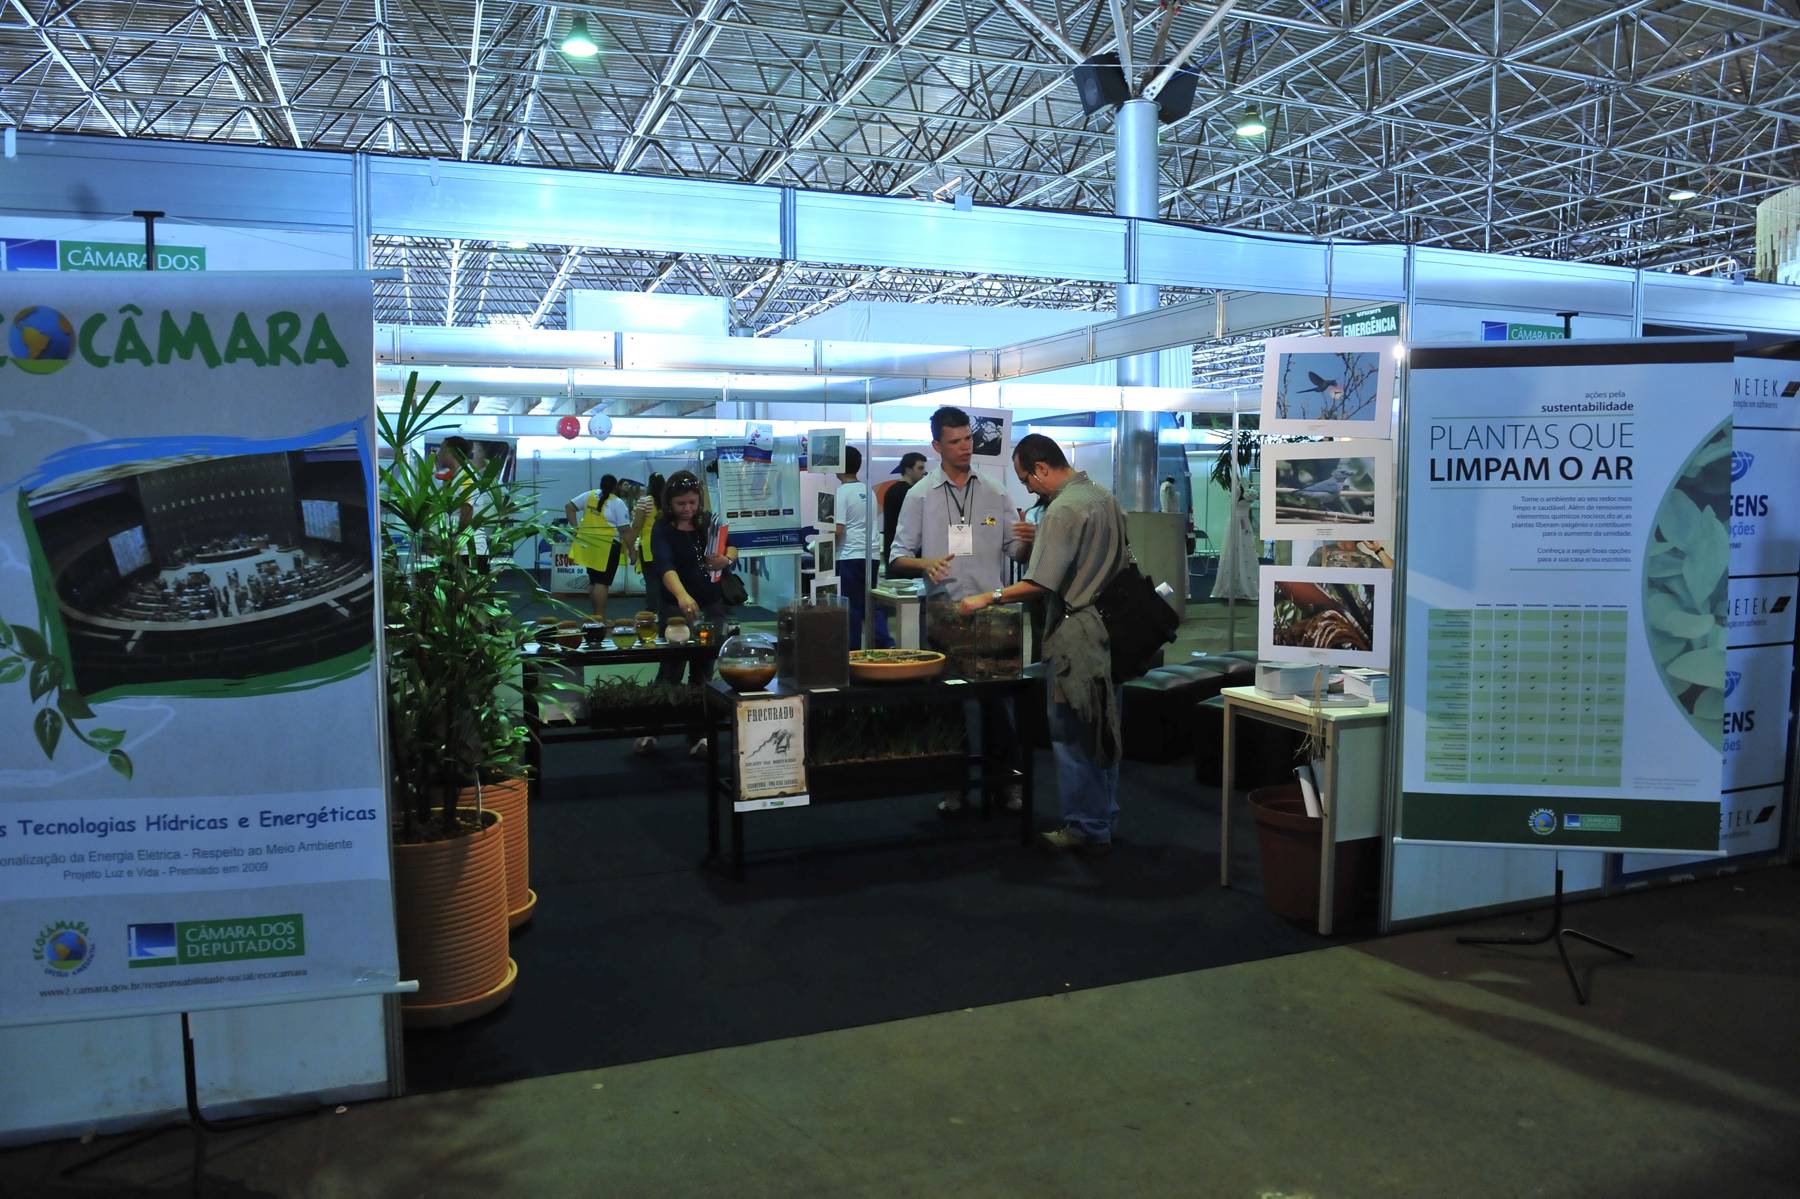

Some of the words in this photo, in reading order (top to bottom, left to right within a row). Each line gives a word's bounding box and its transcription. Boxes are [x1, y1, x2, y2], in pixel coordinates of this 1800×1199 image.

[157, 253, 200, 271] DOS
[1343, 316, 1396, 337] EMERGÊNCIA
[1585, 391, 1607, 399] ações
[1608, 390, 1625, 399] pela
[1542, 401, 1634, 412] sustentabilidade
[1430, 423, 1559, 450] PLANTAS
[1569, 422, 1634, 451] QUE
[1430, 456, 1550, 481] LIMPAM
[1559, 456, 1583, 481] O
[1592, 455, 1633, 480] AR
[747, 706, 794, 722] PROCURADO
[17, 817, 136, 838] Tecnologias
[146, 813, 228, 832] Hídricas
[238, 816, 250, 828] e
[259, 806, 377, 829] Energéticas
[69, 852, 85, 863] da
[89, 850, 134, 864] Energia
[138, 848, 181, 861] Elétrica
[192, 847, 245, 860] Respeito
[248, 846, 263, 856] ao
[266, 843, 295, 855] Meio
[298, 840, 353, 853] Ambiente
[64, 869, 101, 882] Projeto
[105, 868, 123, 879] Luz
[127, 870, 134, 878] e
[136, 866, 160, 878] Vida
[169, 862, 220, 876] Premiado
[223, 865, 239, 874] em
[242, 862, 269, 873] 2009
[185, 924, 257, 942] CÂMARA
[261, 921, 296, 937] DOS
[187, 937, 296, 957] DEPUTADOS
